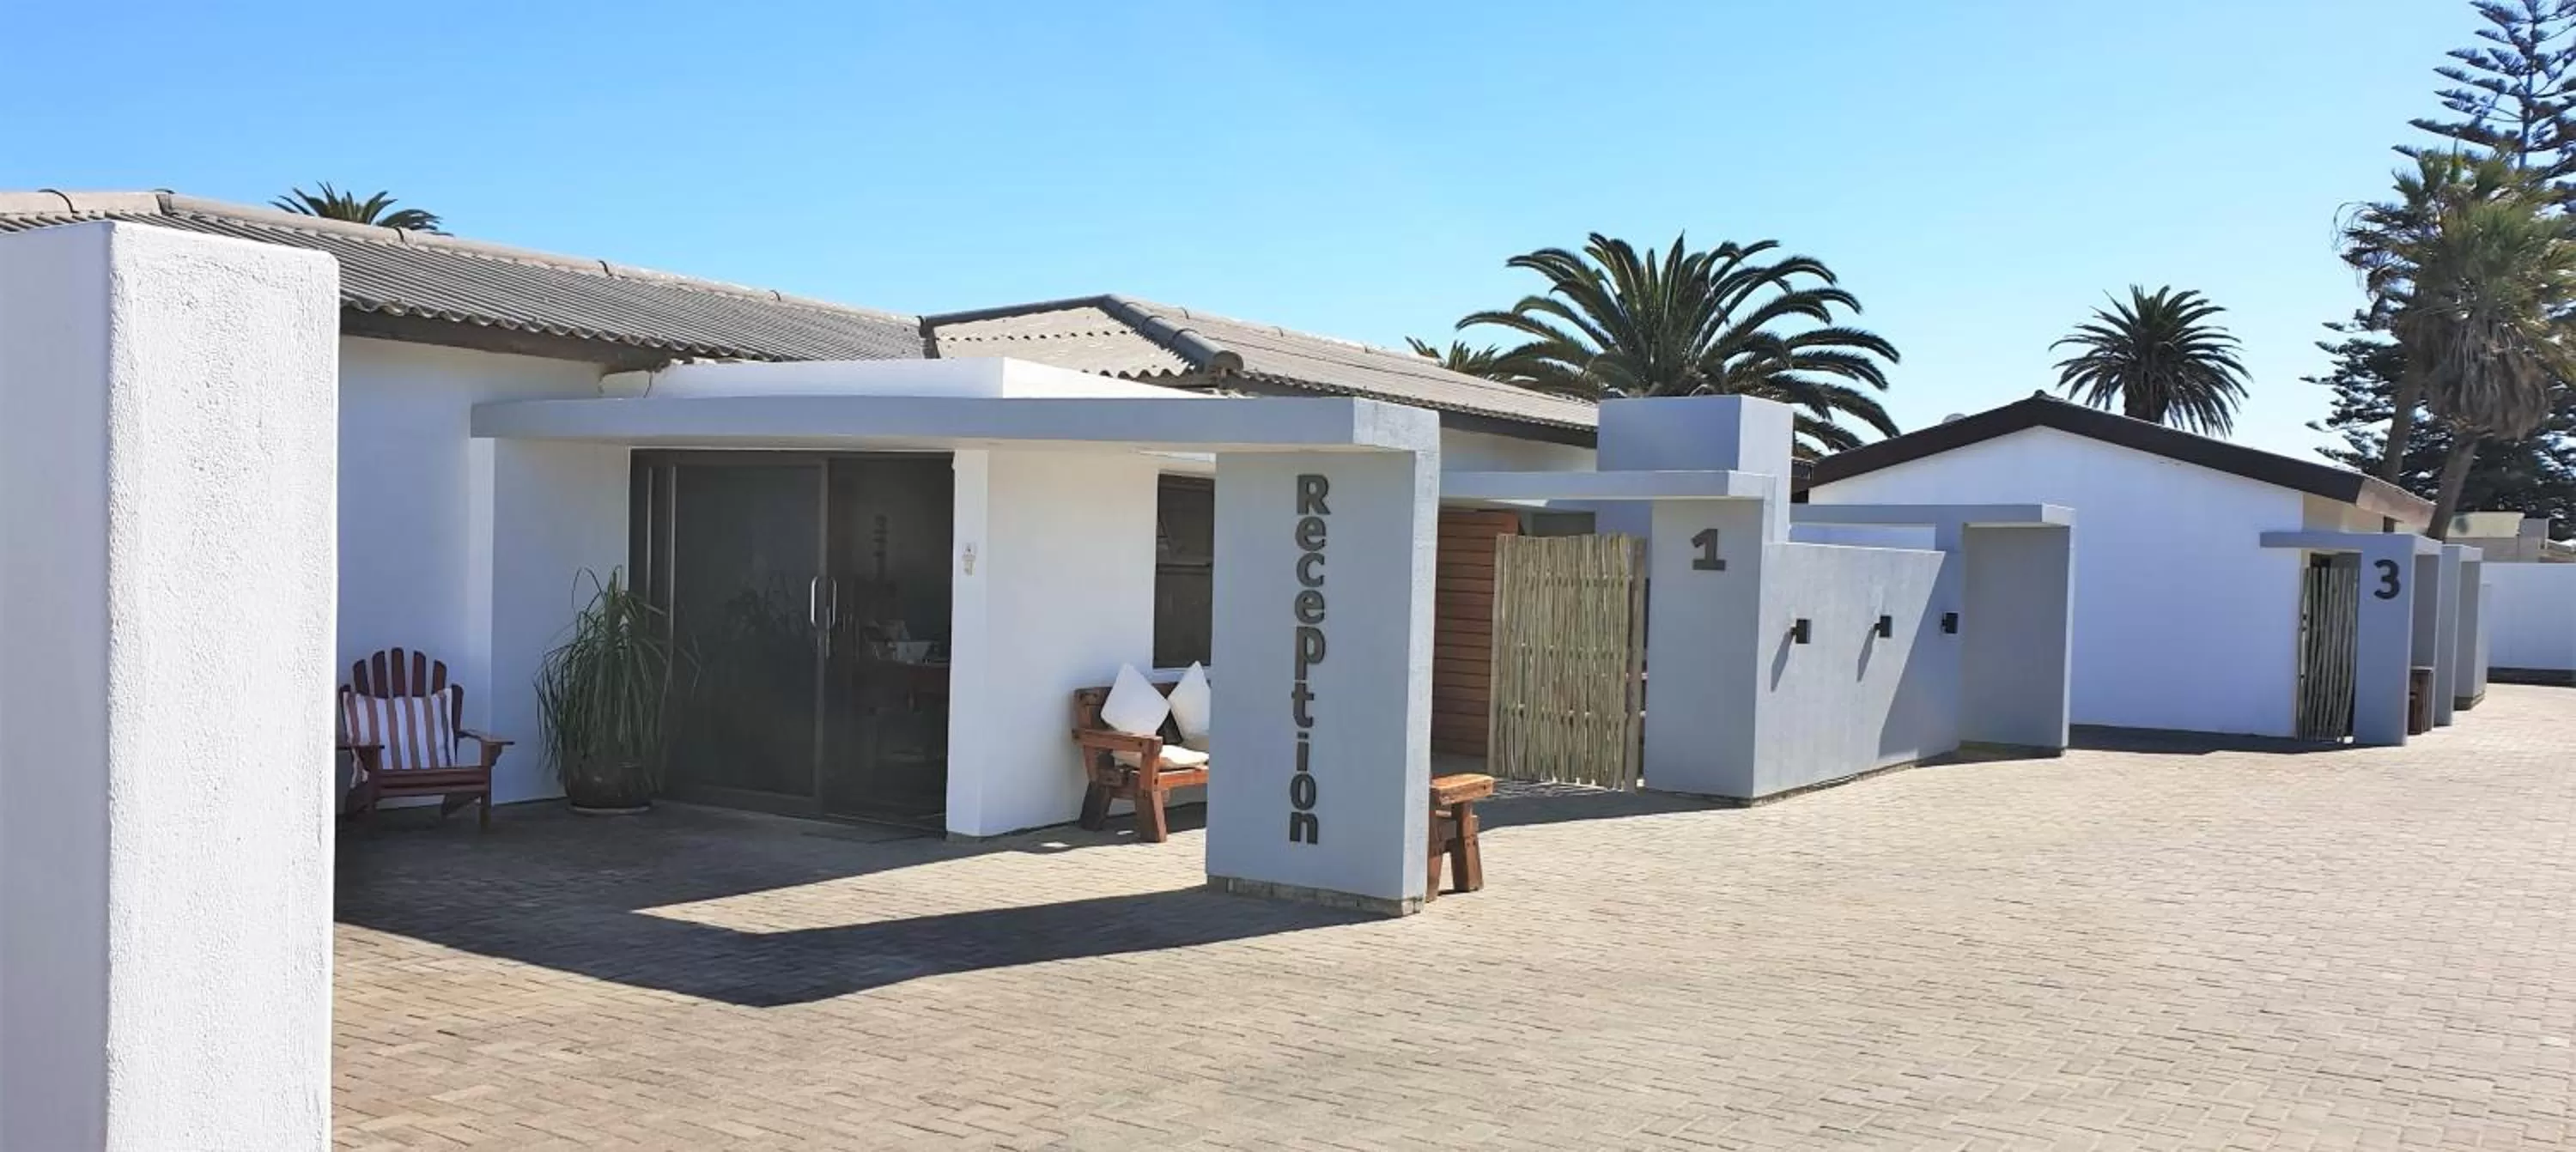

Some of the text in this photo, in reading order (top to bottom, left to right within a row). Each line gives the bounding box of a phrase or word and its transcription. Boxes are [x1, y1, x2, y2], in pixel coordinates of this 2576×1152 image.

[1691, 528, 1726, 571] 1
[2374, 559, 2401, 599] 3
[1289, 474, 1330, 845] Reception
